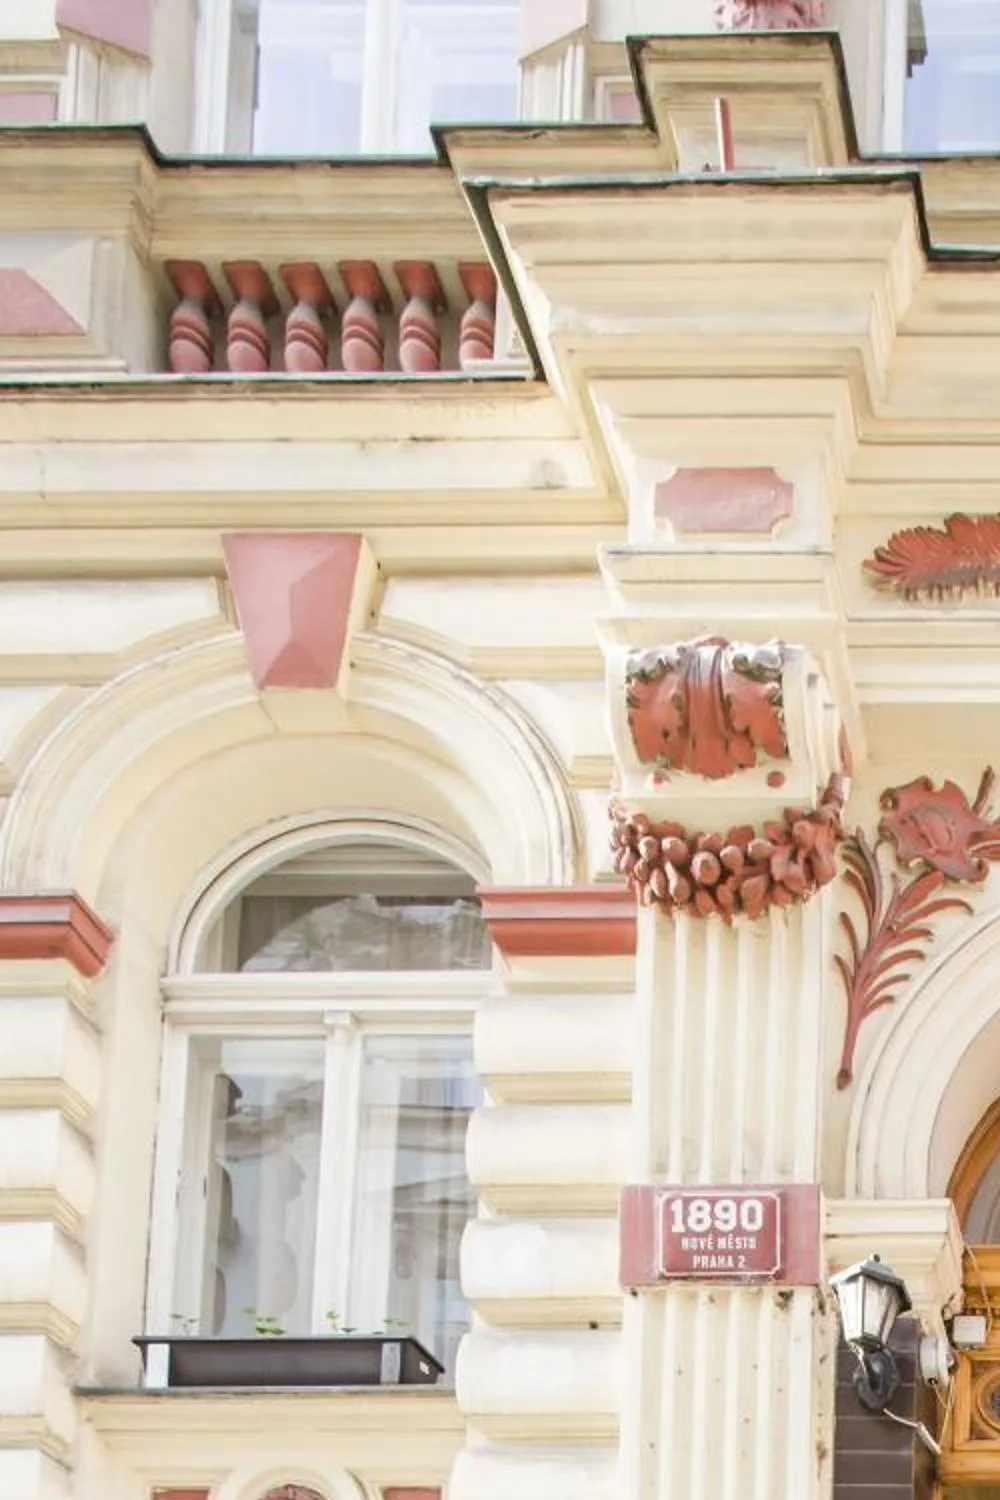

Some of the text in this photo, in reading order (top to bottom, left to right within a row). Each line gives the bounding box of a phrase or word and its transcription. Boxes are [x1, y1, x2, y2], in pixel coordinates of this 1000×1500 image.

[670, 1199, 764, 1233] 1890
[681, 1233, 714, 1250] NOVÉ
[692, 1255, 746, 1269] PRAHA 2
